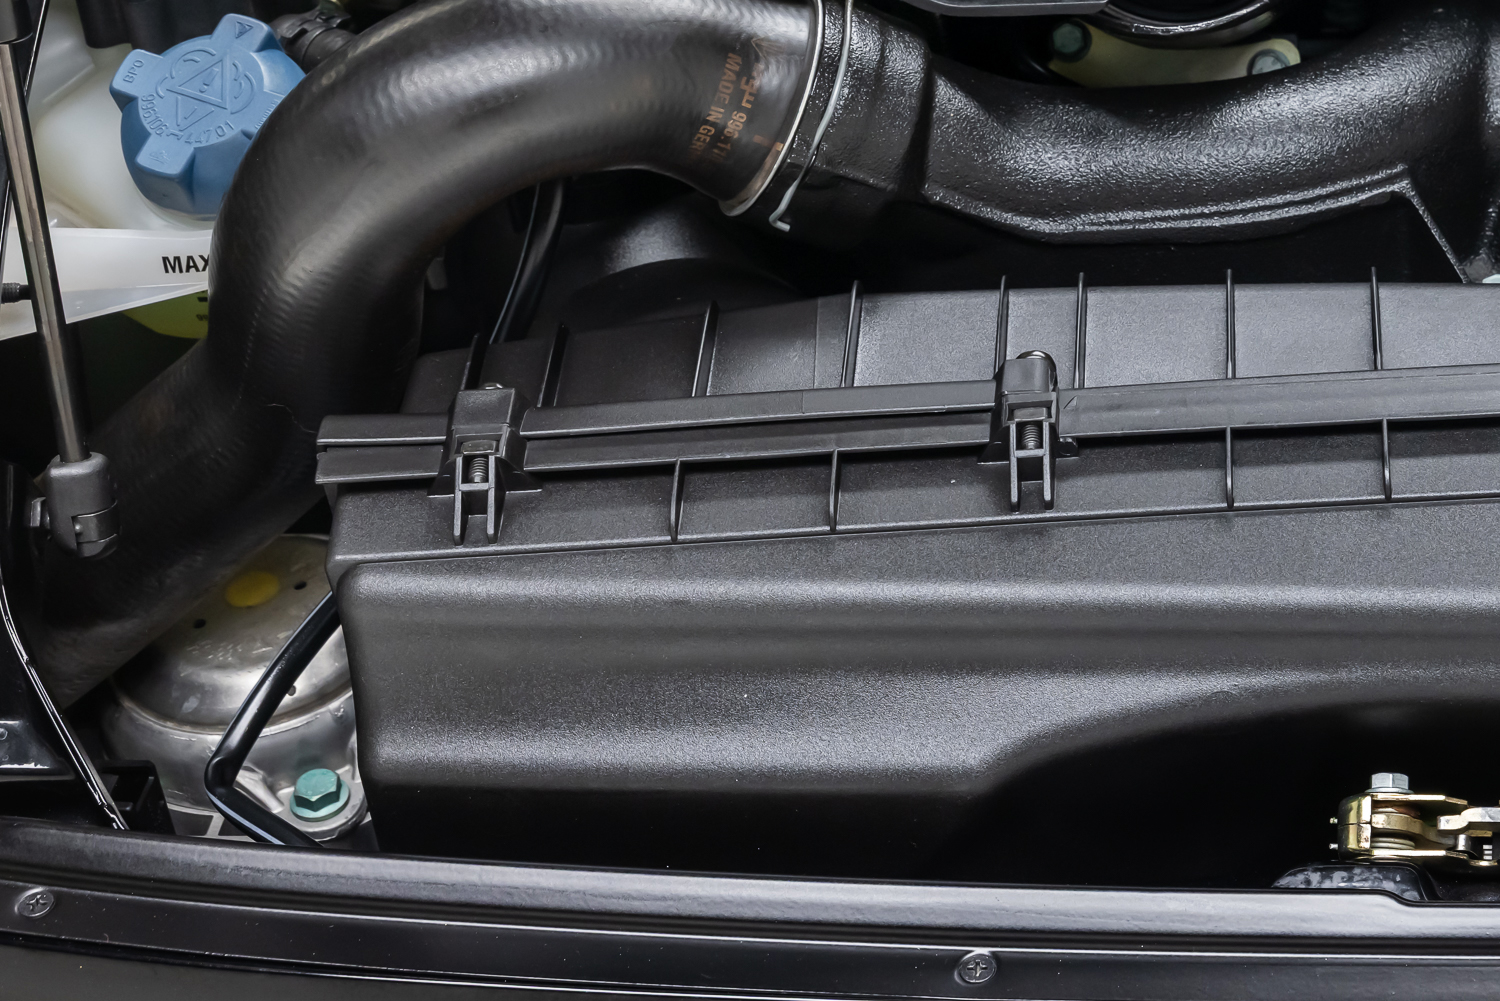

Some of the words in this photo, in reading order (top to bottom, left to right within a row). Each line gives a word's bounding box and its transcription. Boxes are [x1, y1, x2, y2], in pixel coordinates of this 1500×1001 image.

[714, 52, 742, 104] MADE
[706, 106, 725, 122] IN
[161, 254, 209, 274] MAX
